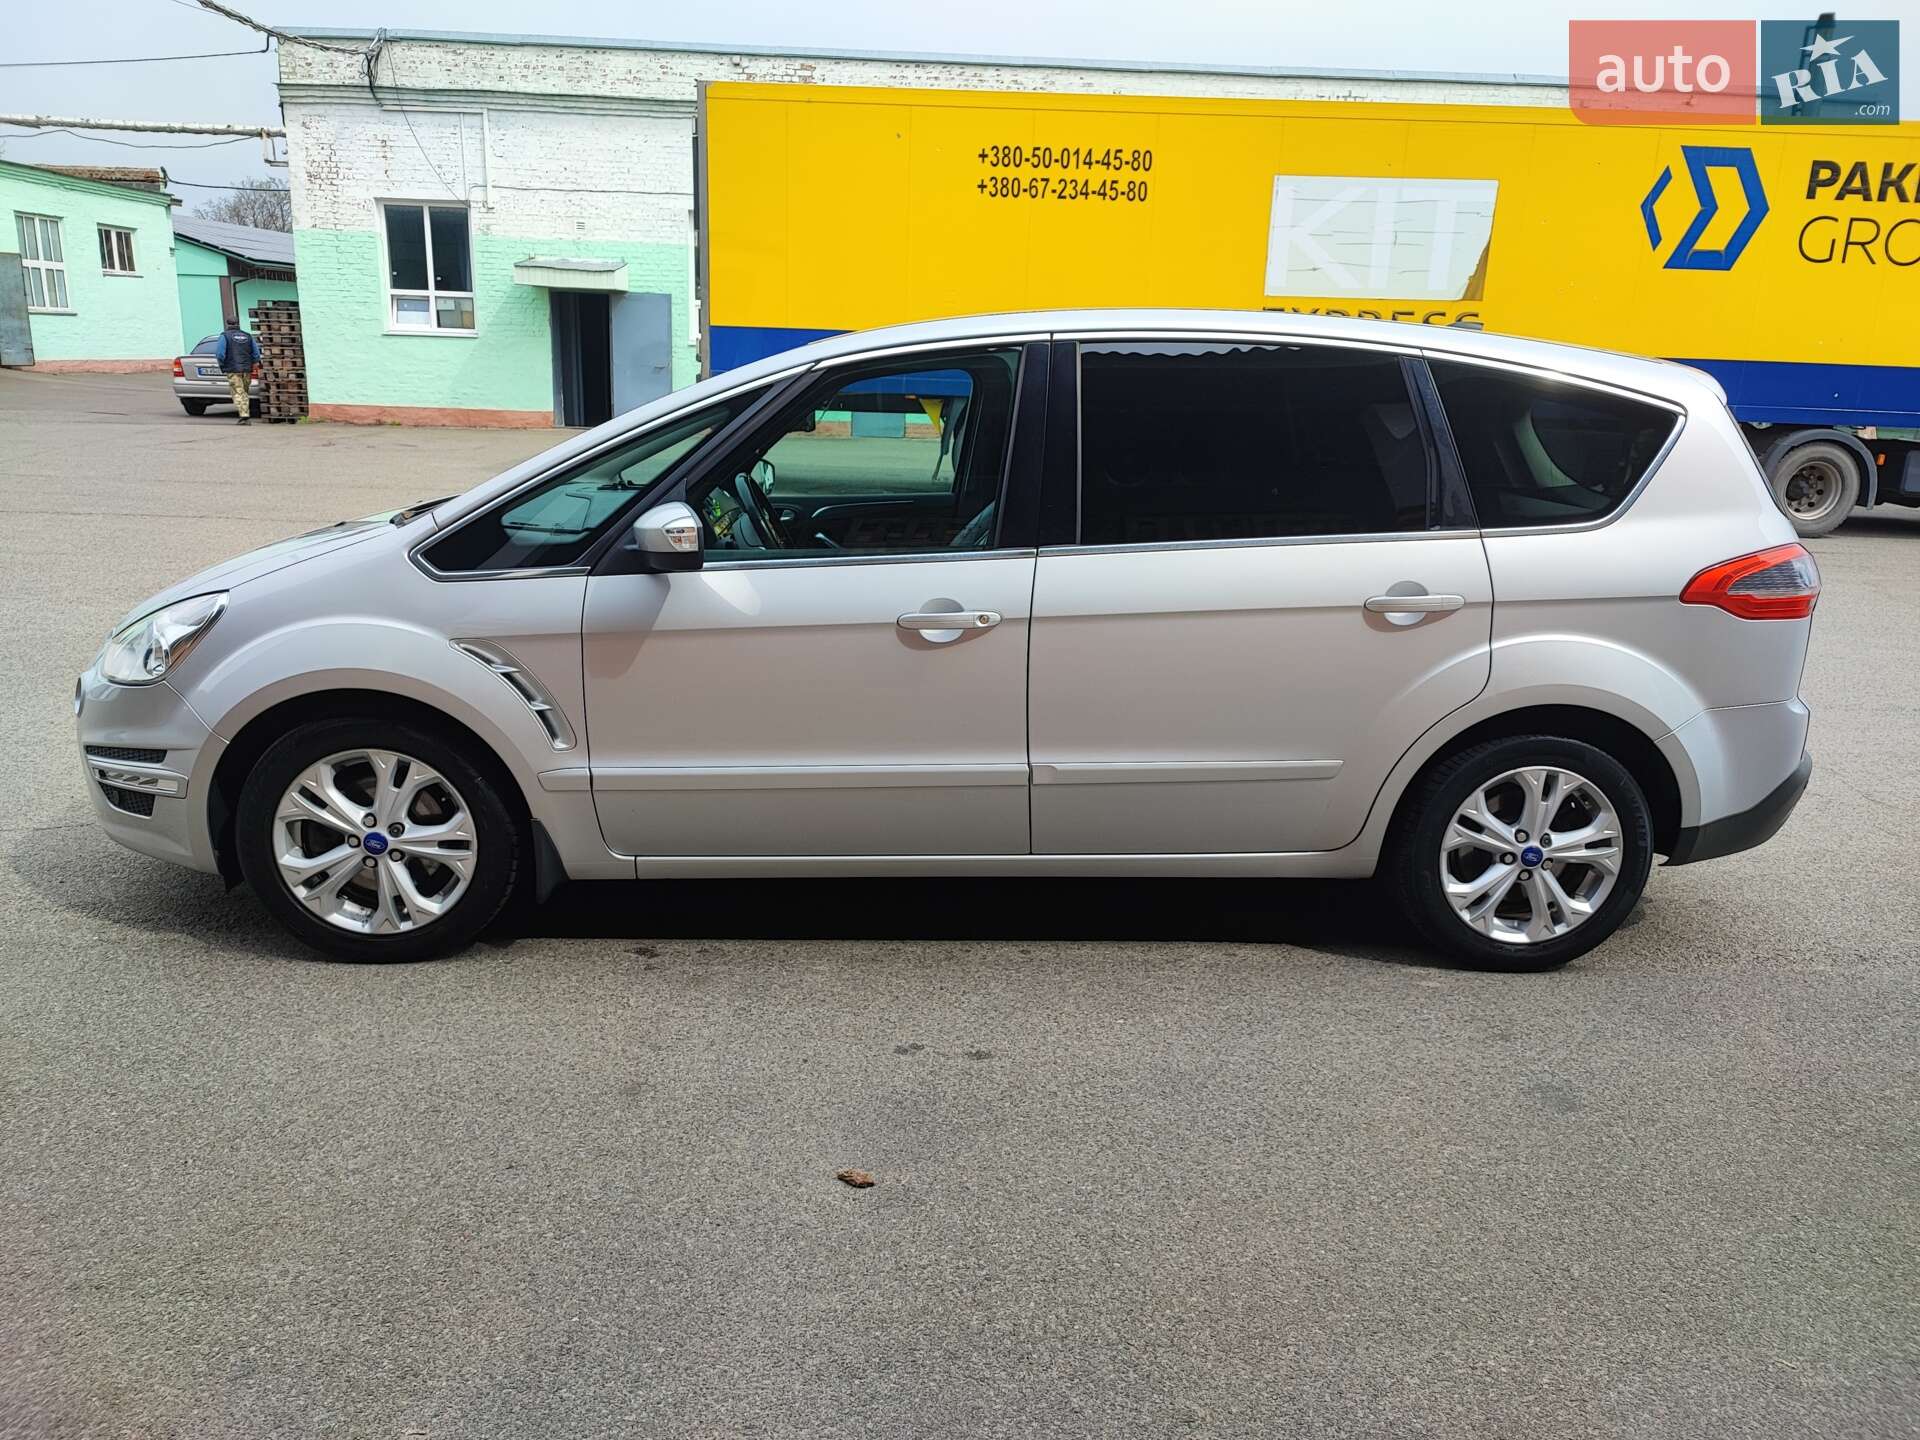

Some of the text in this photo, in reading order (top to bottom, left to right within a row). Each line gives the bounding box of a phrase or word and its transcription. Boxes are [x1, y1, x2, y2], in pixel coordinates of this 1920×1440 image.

[978, 146, 1152, 171] +380-50-014-45-80
[977, 176, 1148, 201] +380-67-234-45-80
[1806, 159, 1920, 203] PAK
[1799, 216, 1920, 266] GRO
